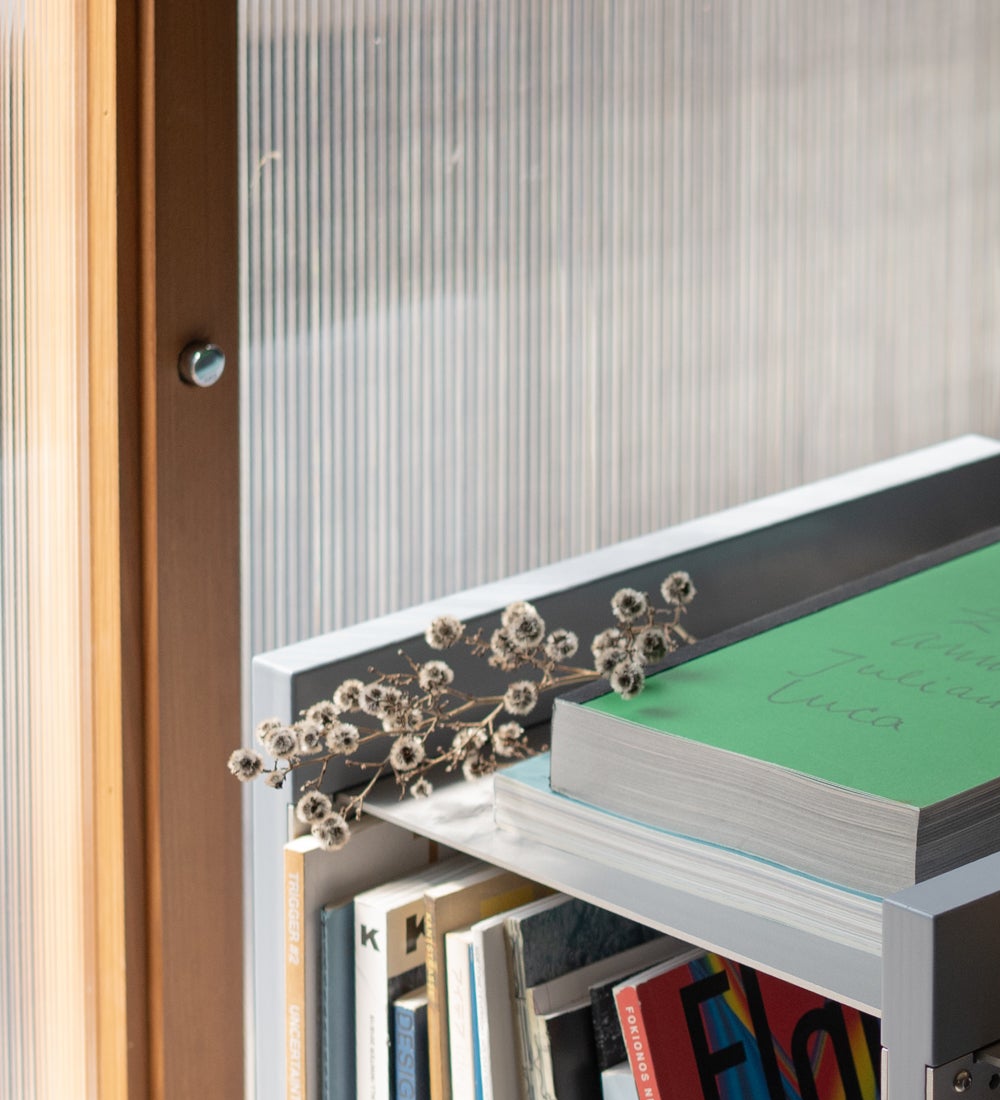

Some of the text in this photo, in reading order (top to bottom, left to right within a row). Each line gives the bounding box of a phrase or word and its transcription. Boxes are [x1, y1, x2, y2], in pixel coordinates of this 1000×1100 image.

[288, 872, 299, 943] TRIGGER
[360, 924, 380, 952] K
[625, 1005, 650, 1082] FOKIONOS
